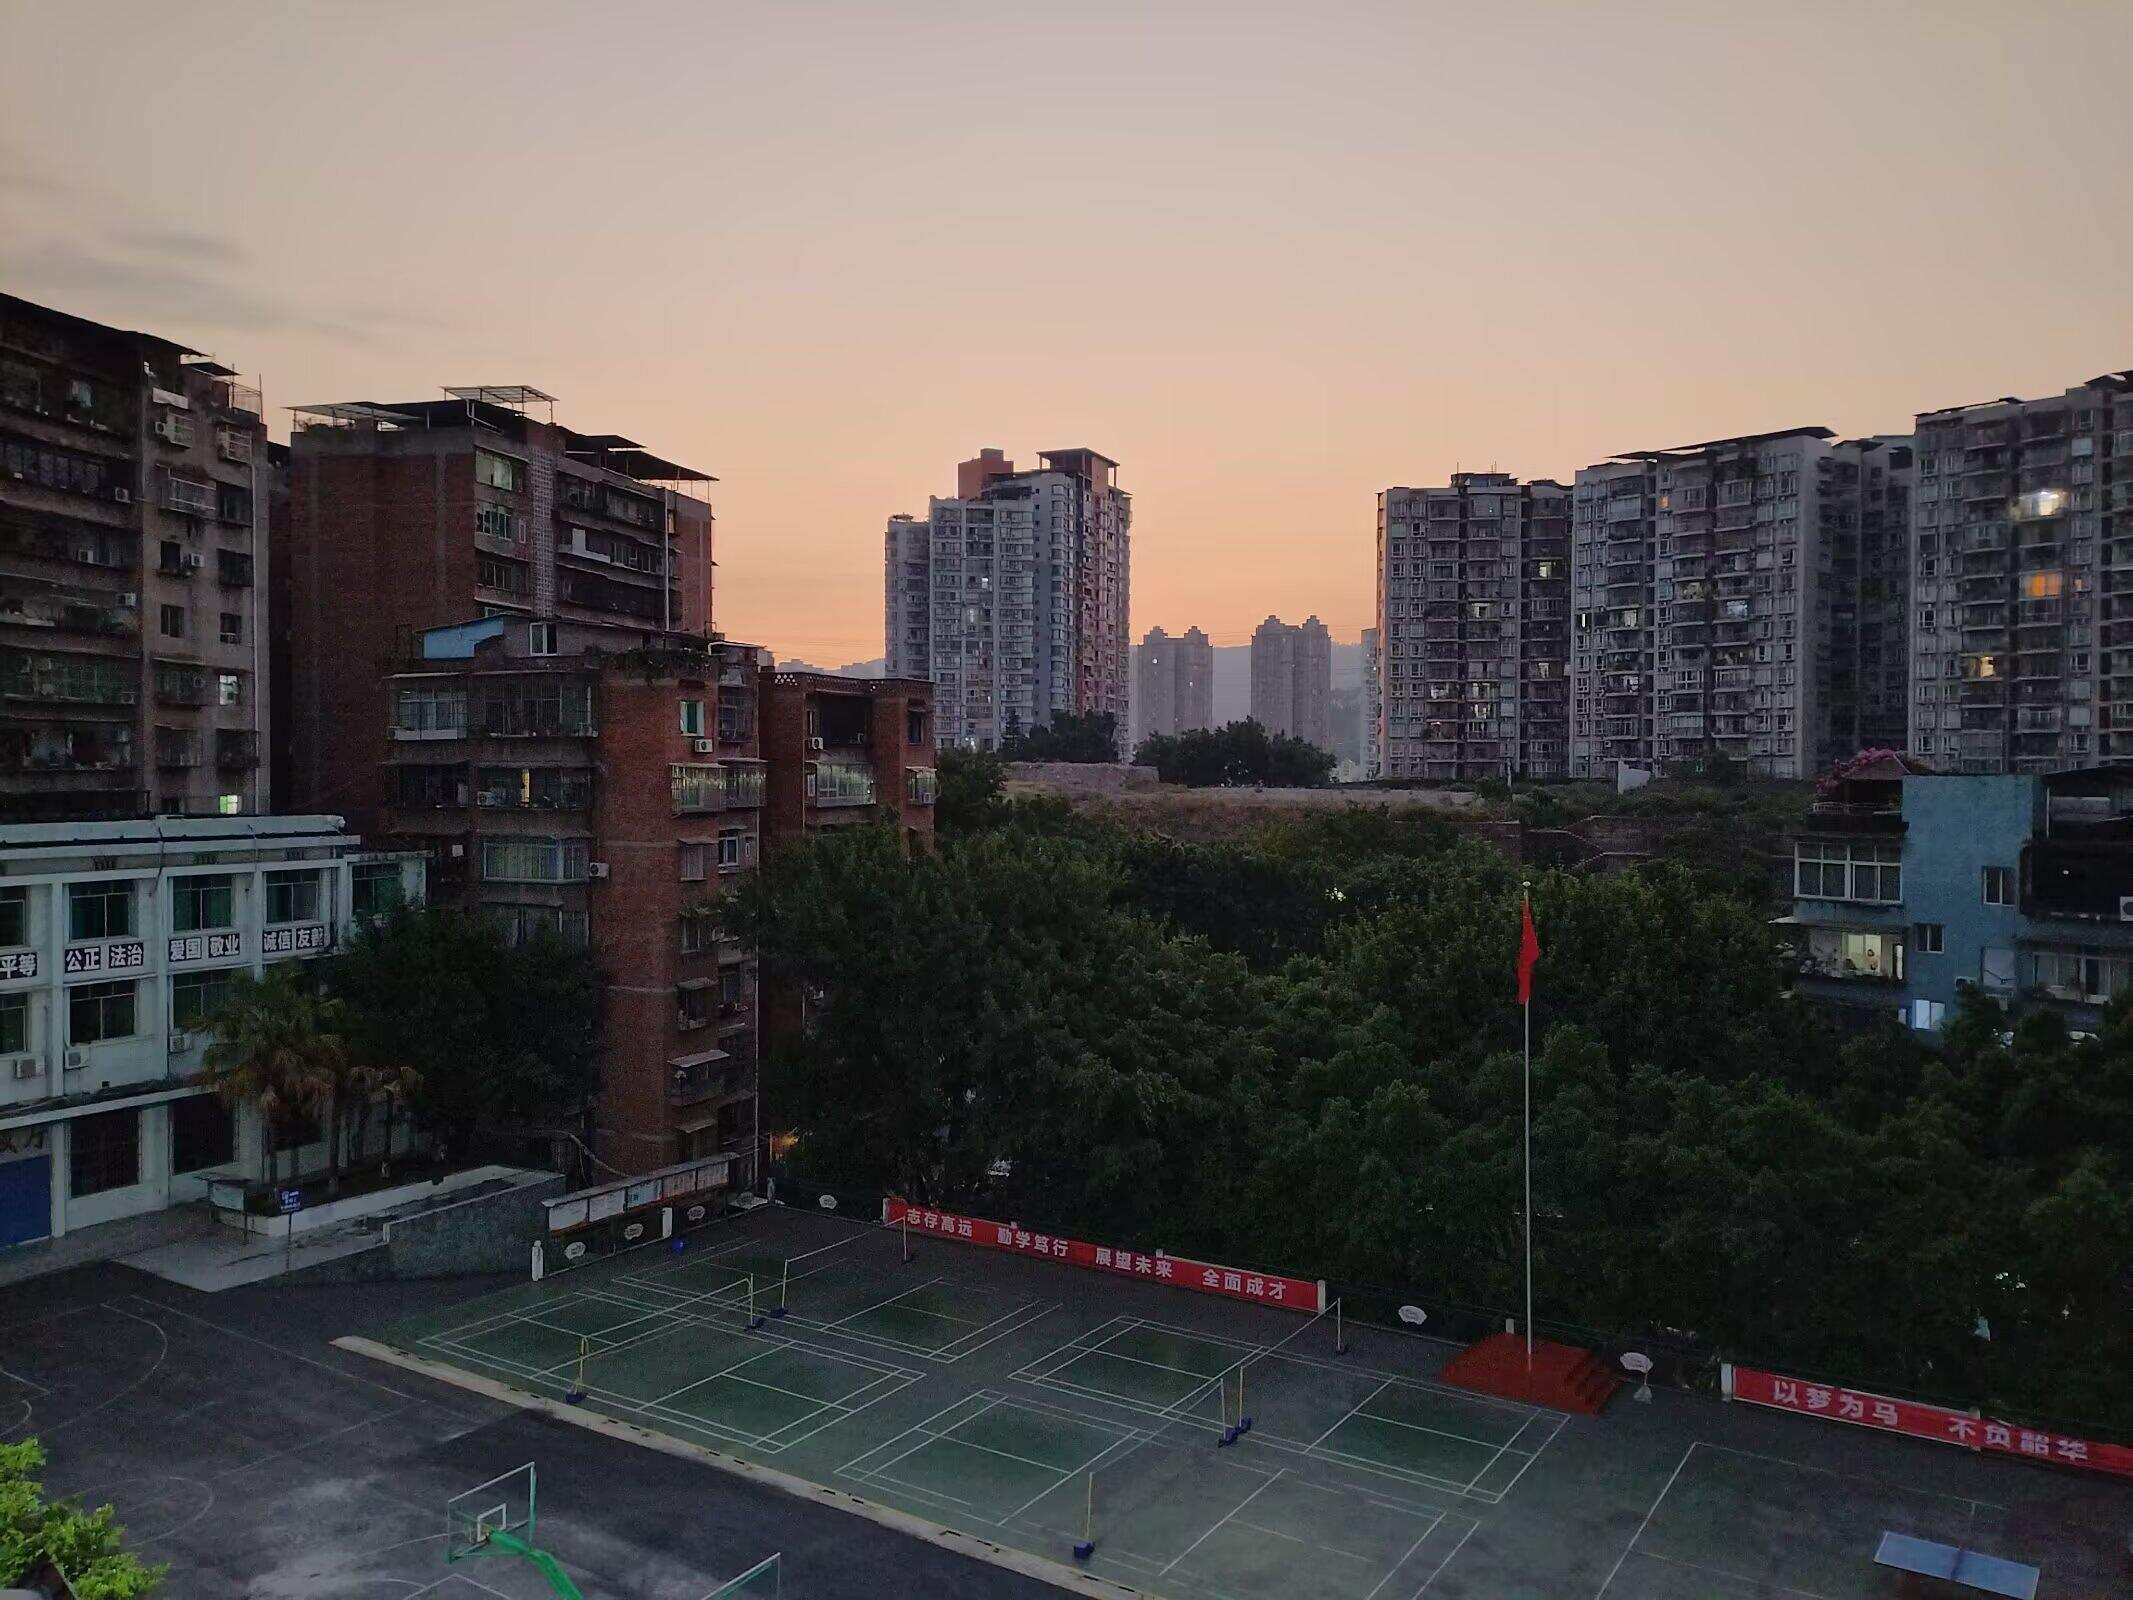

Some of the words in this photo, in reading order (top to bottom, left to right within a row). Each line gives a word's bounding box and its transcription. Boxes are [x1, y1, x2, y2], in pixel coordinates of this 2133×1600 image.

[0, 954, 36, 978] 平等
[66, 948, 100, 972] 公正
[111, 944, 142, 967] 法治
[170, 938, 201, 960] 爱国
[210, 934, 240, 957] 敬业
[264, 931, 292, 951] 诚信
[906, 1208, 974, 1237] 志存高远
[1096, 1247, 1173, 1278] 展望未来
[1202, 1268, 1287, 1300] 全面成才
[1774, 1380, 1898, 1426] 以梦为马
[1949, 1417, 2088, 1460] 不负韶华
